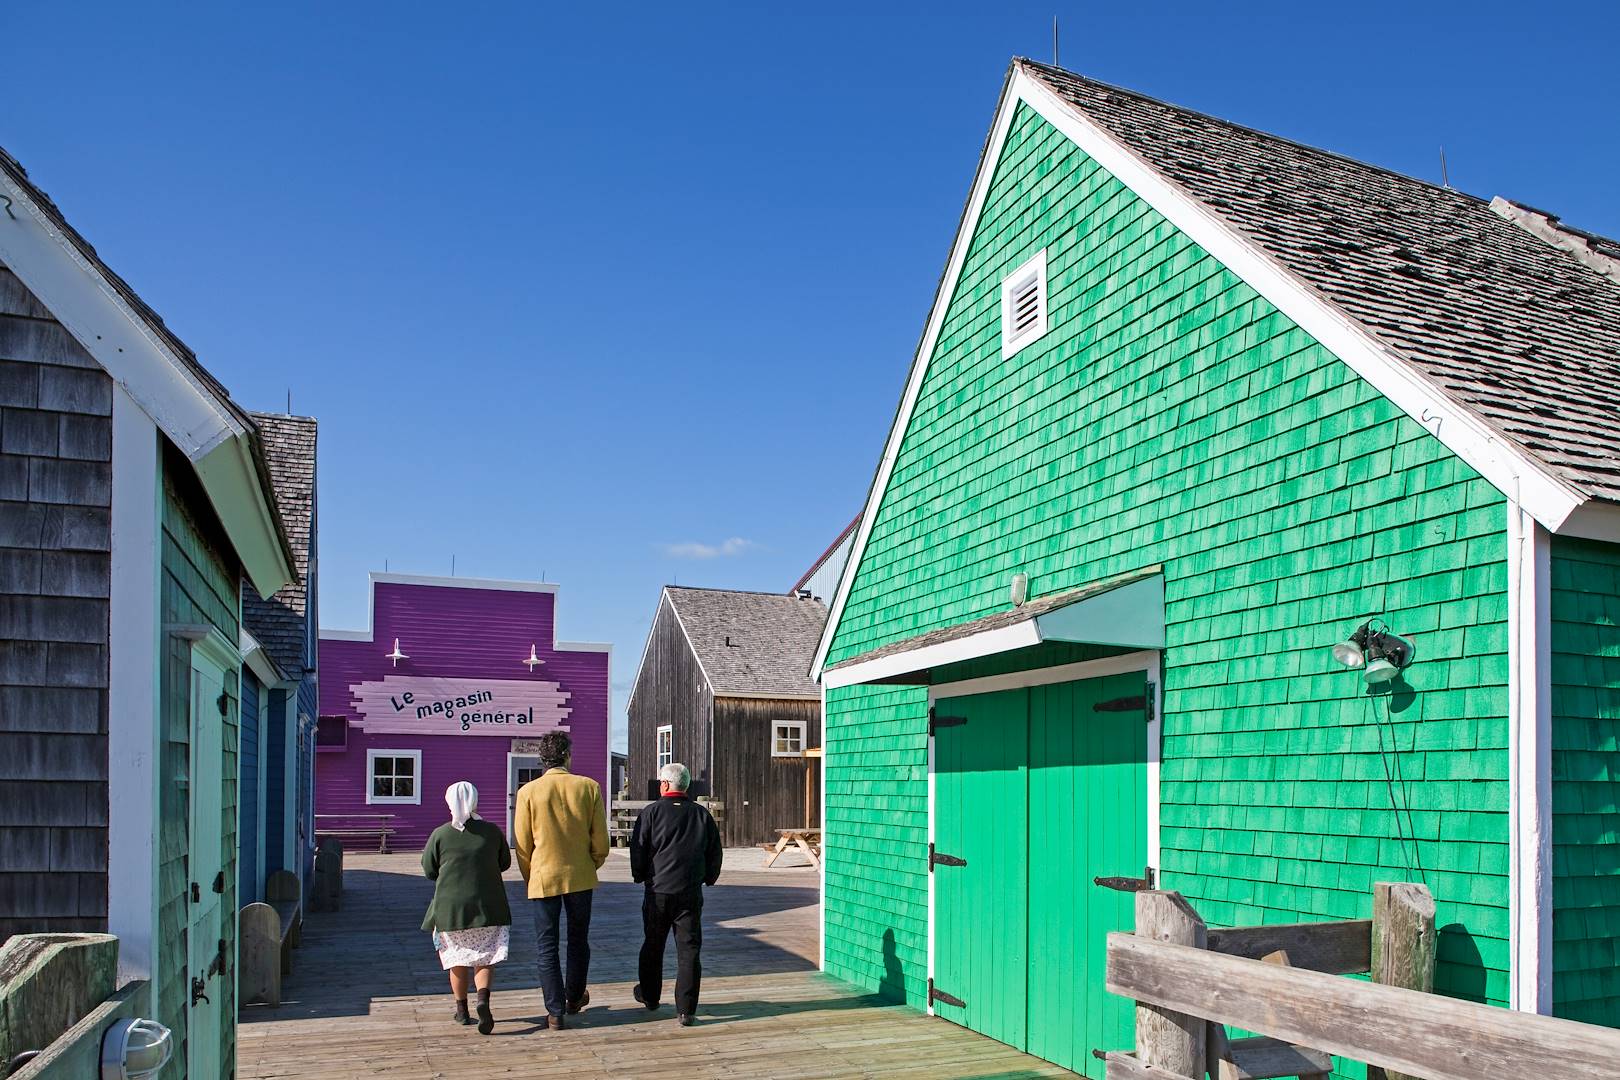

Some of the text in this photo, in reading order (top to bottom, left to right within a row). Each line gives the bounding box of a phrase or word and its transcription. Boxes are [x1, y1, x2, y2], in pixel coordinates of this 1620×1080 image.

[390, 690, 493, 720] Le magasin
[460, 706, 534, 731] général
